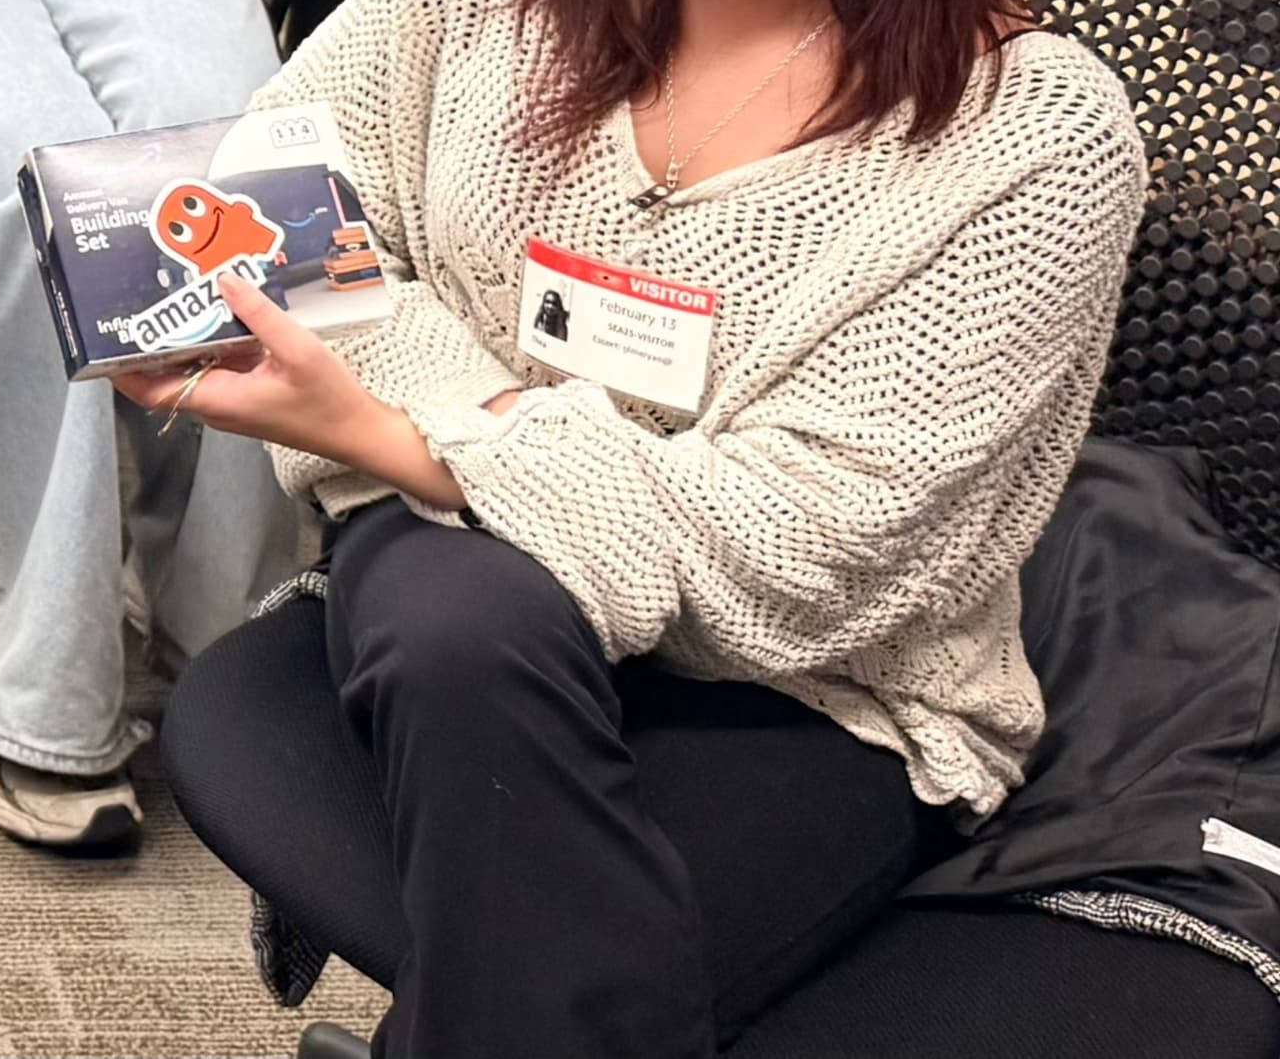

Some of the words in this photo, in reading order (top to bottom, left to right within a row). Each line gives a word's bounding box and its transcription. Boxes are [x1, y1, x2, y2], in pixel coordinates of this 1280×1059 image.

[70, 209, 149, 235] Building
[75, 232, 110, 253] Set
[136, 260, 257, 345] amazn
[629, 276, 708, 310] VISITOR
[600, 298, 656, 328] February
